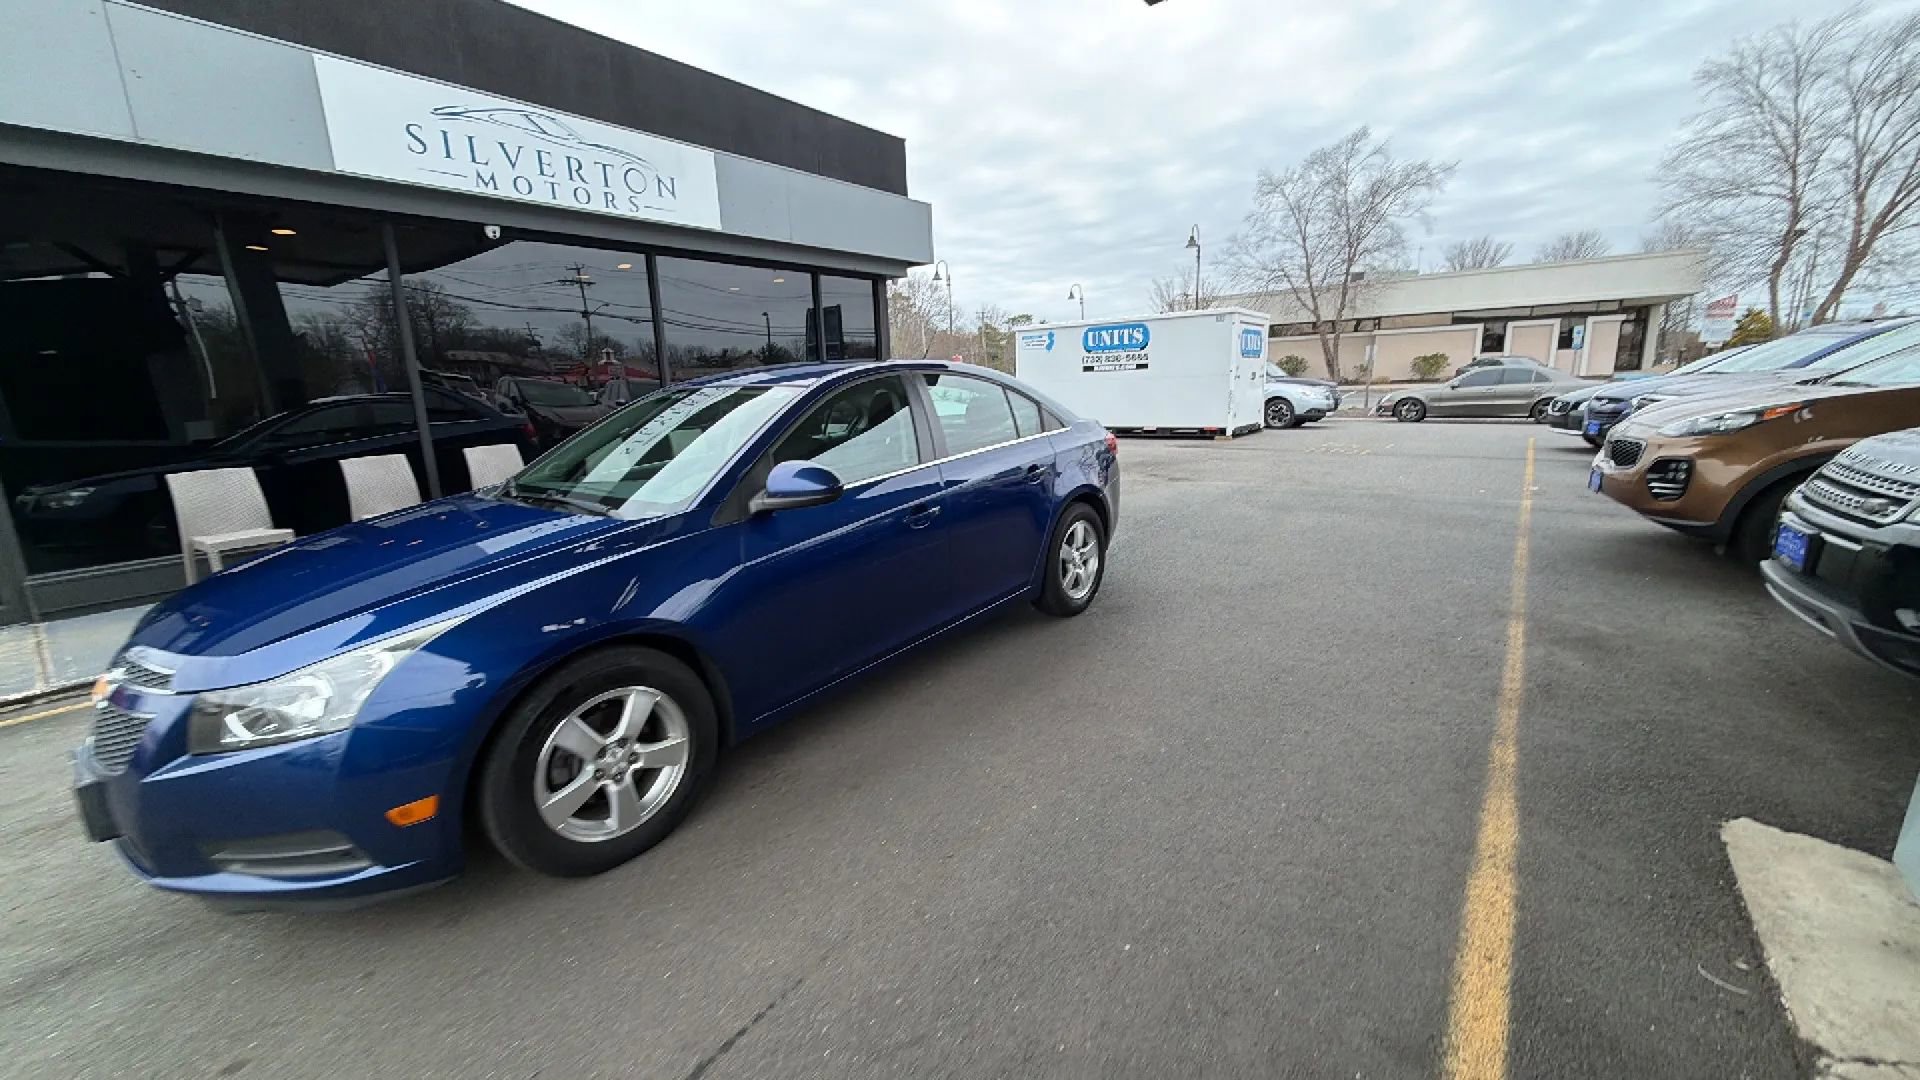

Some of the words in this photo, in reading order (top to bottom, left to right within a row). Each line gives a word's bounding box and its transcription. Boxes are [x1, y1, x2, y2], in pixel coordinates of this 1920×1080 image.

[405, 123, 677, 200] SILVERTON
[475, 168, 640, 213] MOTORS
[1087, 327, 1143, 347] UNITS
